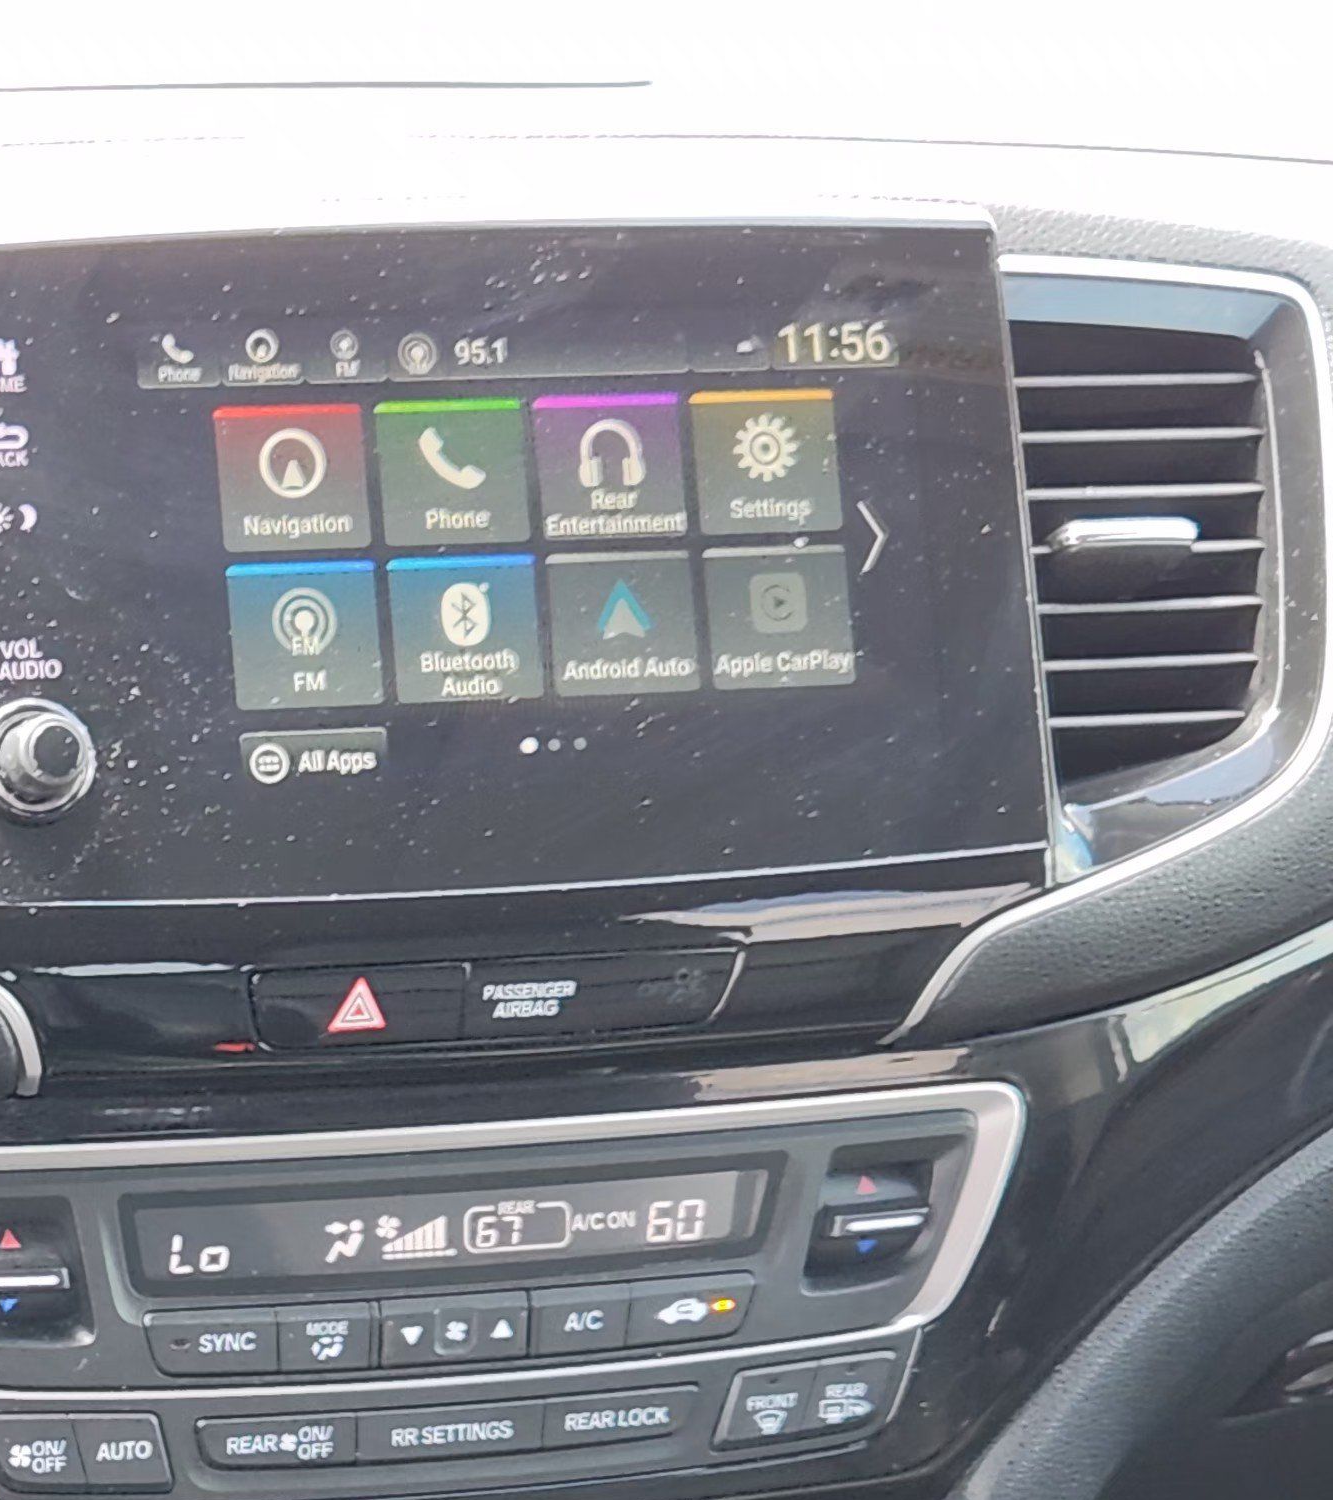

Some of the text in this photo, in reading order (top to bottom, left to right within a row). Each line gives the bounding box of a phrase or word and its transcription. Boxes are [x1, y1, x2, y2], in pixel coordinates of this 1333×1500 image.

[454, 336, 509, 366] 95.1
[778, 320, 896, 364] 11:56
[590, 488, 639, 510] Rear
[425, 509, 491, 532] Phone
[730, 497, 813, 525] Settings
[243, 512, 353, 539] Navigation
[545, 510, 687, 537] Entertainment
[0, 637, 43, 660] VOL
[420, 648, 518, 674] Bluetooth
[562, 655, 695, 682] Android Auto
[713, 648, 853, 679] Apple CarPlay
[293, 669, 328, 692] FM
[441, 676, 502, 698] Audio
[298, 750, 377, 776] All Apps
[482, 979, 576, 1002] PASSENGER
[492, 999, 560, 1019] AIRBAG
[475, 1215, 524, 1248] 67
[646, 1198, 706, 1244] 60
[169, 1233, 231, 1275] Lo
[306, 1319, 349, 1338] MODE
[564, 1309, 605, 1332] A/C
[198, 1330, 258, 1352] SYNC
[746, 1391, 799, 1412] FRONT
[825, 1381, 868, 1400] REAR
[564, 1406, 670, 1432] REAR LOCK
[226, 1433, 279, 1456] REAR
[391, 1420, 514, 1447] RR SETTINGS
[96, 1439, 154, 1461] AUTO
[296, 1441, 334, 1460] OFF
[30, 1455, 68, 1475] OFF
